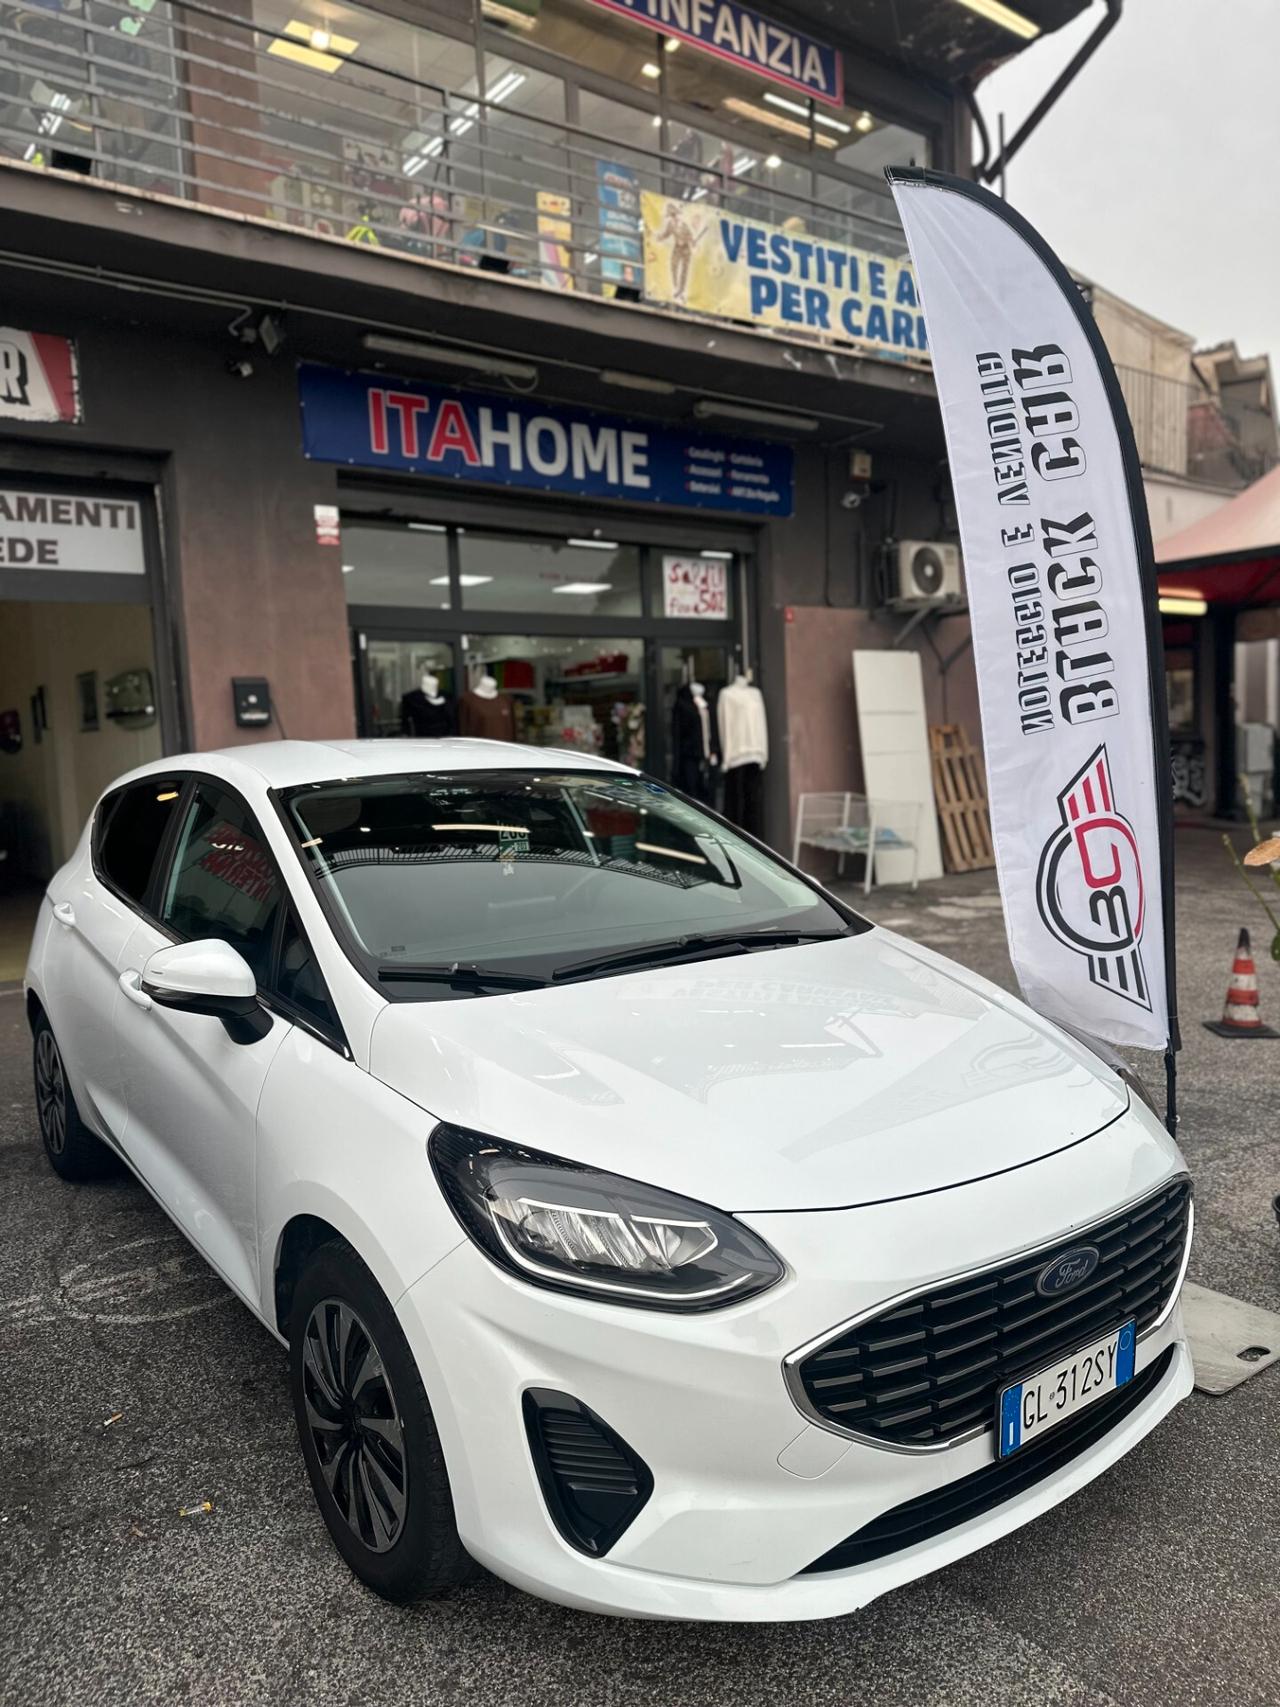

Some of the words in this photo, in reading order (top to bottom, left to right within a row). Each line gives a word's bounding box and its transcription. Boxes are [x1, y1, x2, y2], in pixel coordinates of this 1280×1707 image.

[720, 219, 859, 292] VESTITI
[868, 261, 887, 299] E
[895, 269, 920, 308] A
[750, 275, 830, 330] PER
[367, 387, 651, 489] ITAHOME
[0, 536, 59, 565] DE
[1055, 1257, 1089, 1289] Ford
